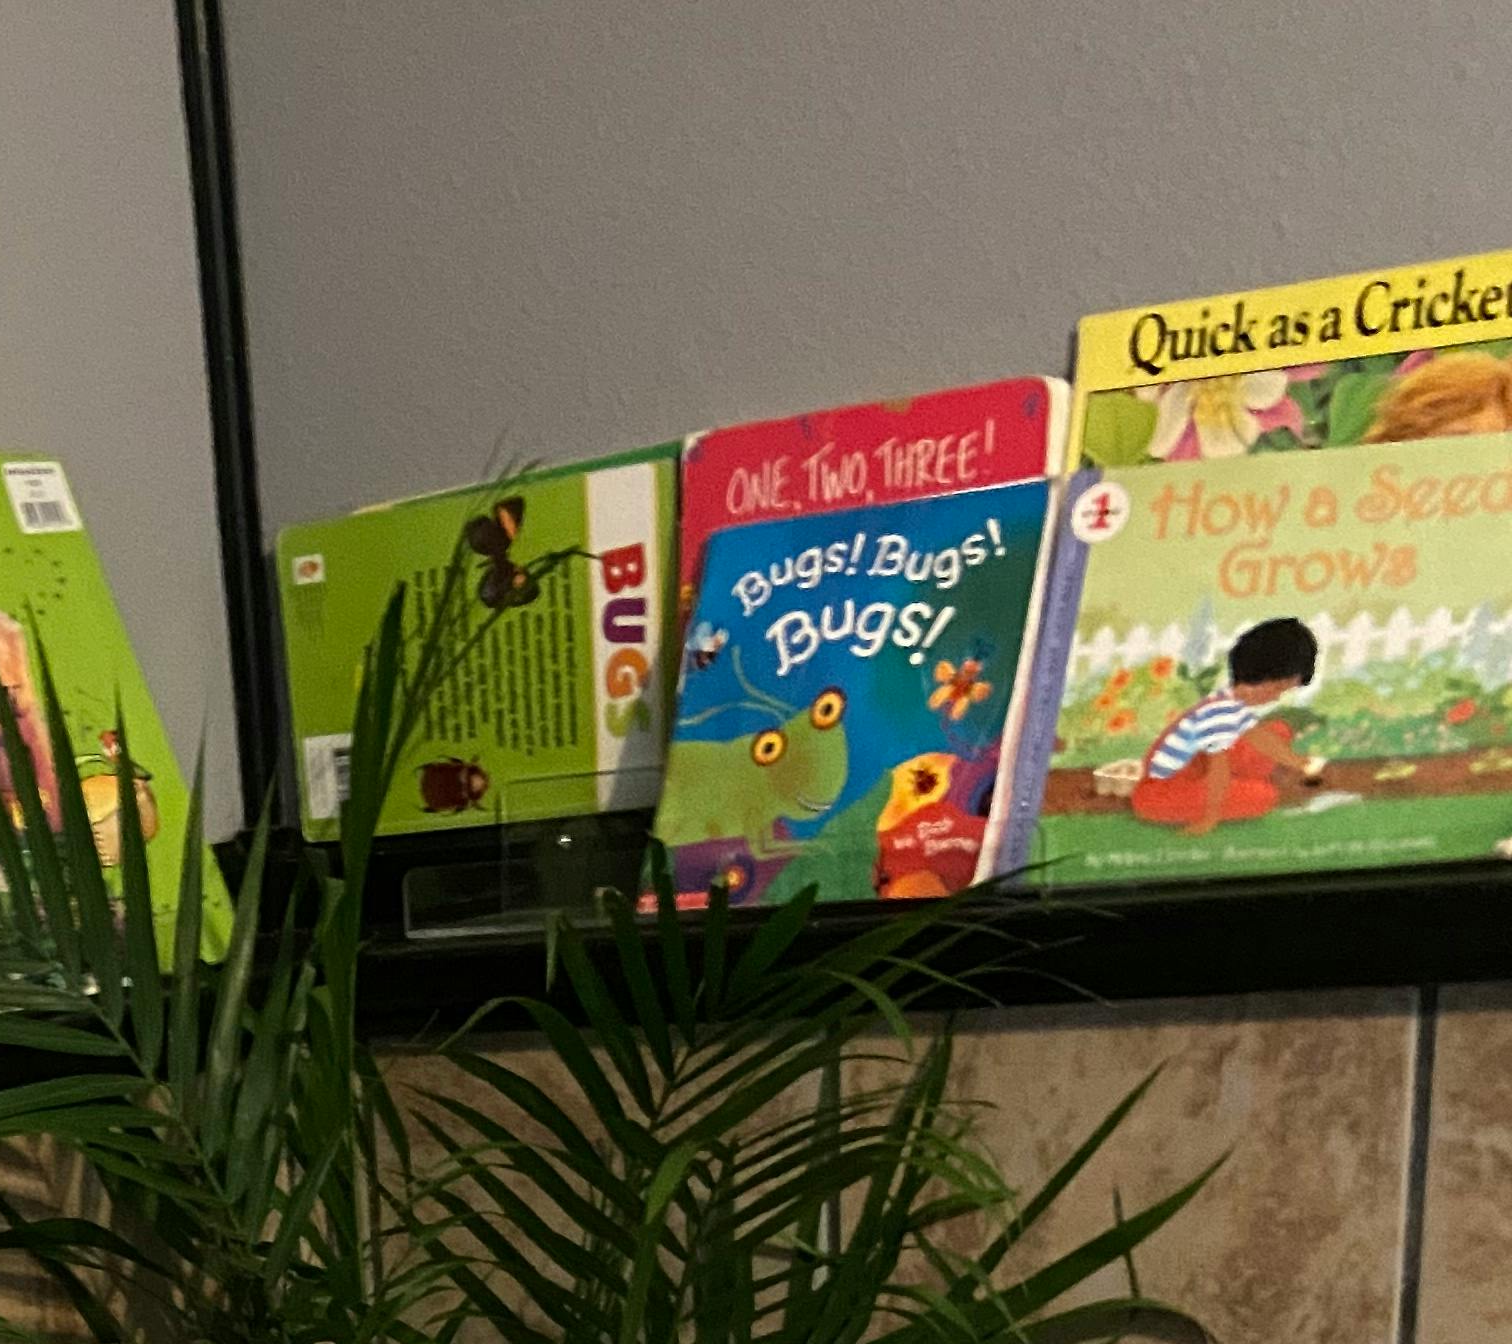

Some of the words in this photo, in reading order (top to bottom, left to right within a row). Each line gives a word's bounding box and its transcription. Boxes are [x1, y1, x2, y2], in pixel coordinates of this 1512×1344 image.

[1129, 302, 1258, 374] Quick
[1269, 310, 1310, 349] as
[1319, 305, 1341, 341] a
[873, 417, 997, 490] THREE!
[1150, 479, 1289, 541] How
[1303, 484, 1337, 513] a
[731, 531, 865, 616] Bugs!
[867, 516, 1007, 590] Bugs!
[1218, 534, 1419, 598] Grows
[600, 543, 651, 738] BUGS
[765, 599, 956, 677] Bugs!
